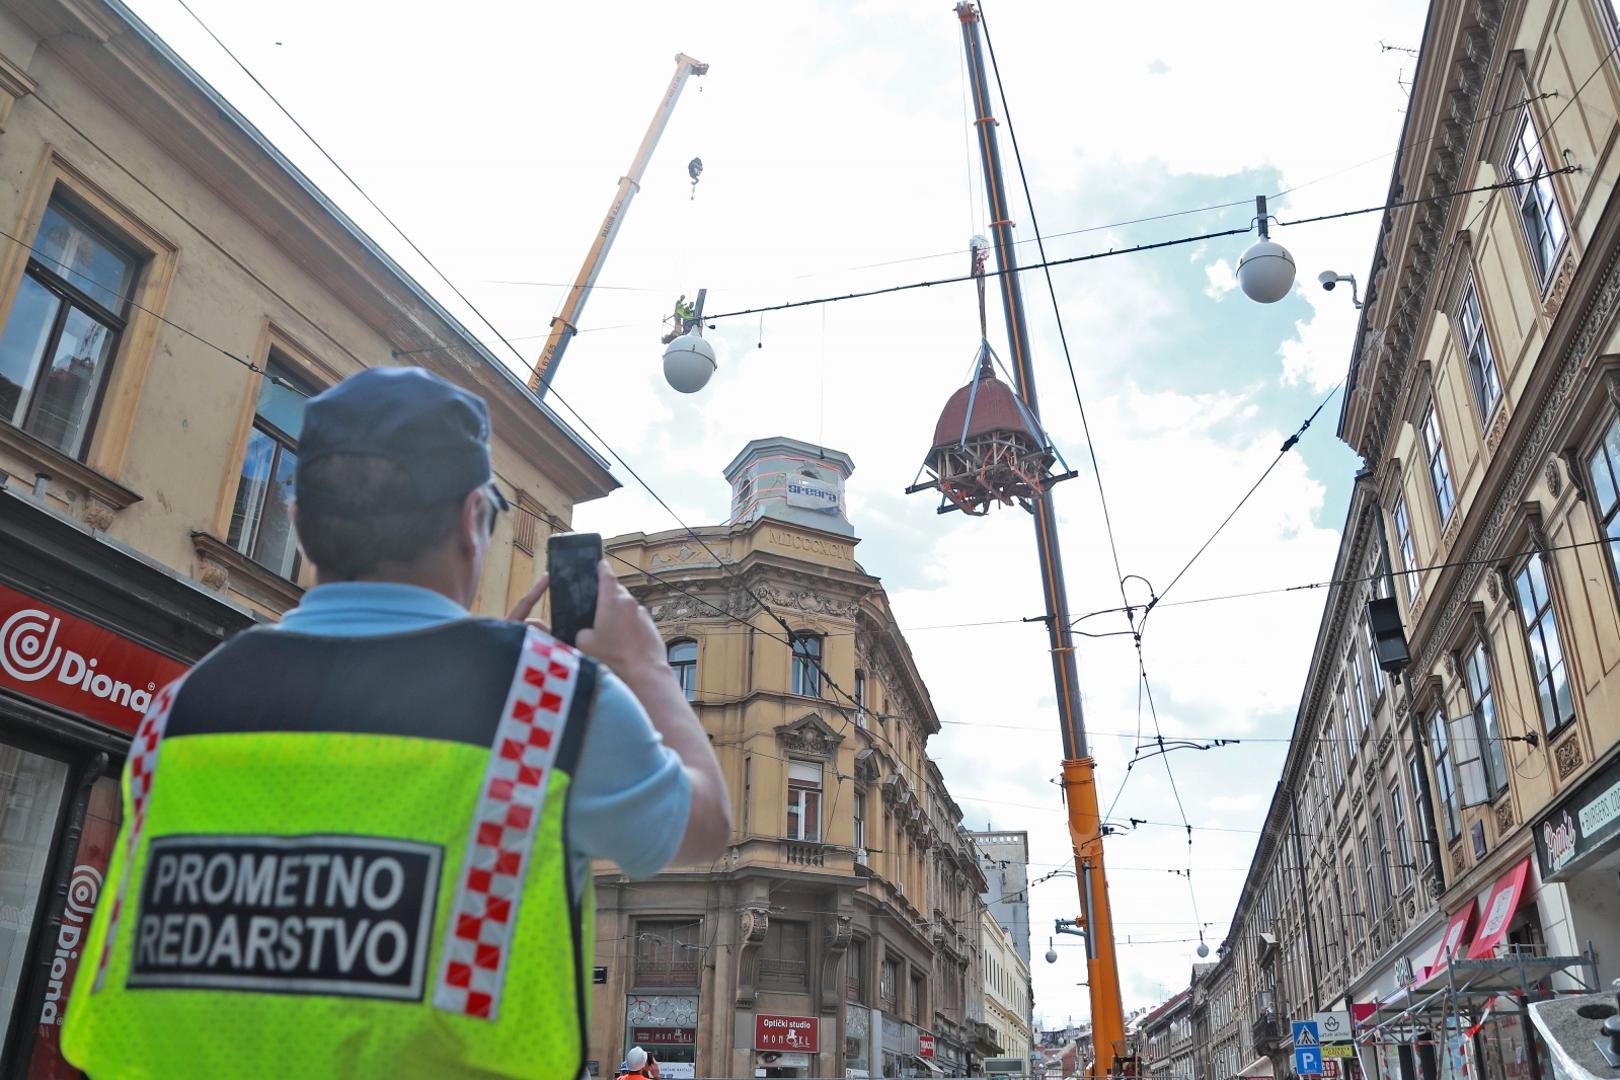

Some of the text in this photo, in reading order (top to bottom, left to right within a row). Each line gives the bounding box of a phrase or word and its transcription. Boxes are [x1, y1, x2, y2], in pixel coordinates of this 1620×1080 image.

[58, 650, 152, 714] Diona
[153, 854, 405, 911] PROMETNO
[40, 924, 81, 1025] Diona
[136, 914, 408, 976] REDARSTVO
[763, 1018, 811, 1029] Optički studio
[1302, 1053, 1314, 1069] P
